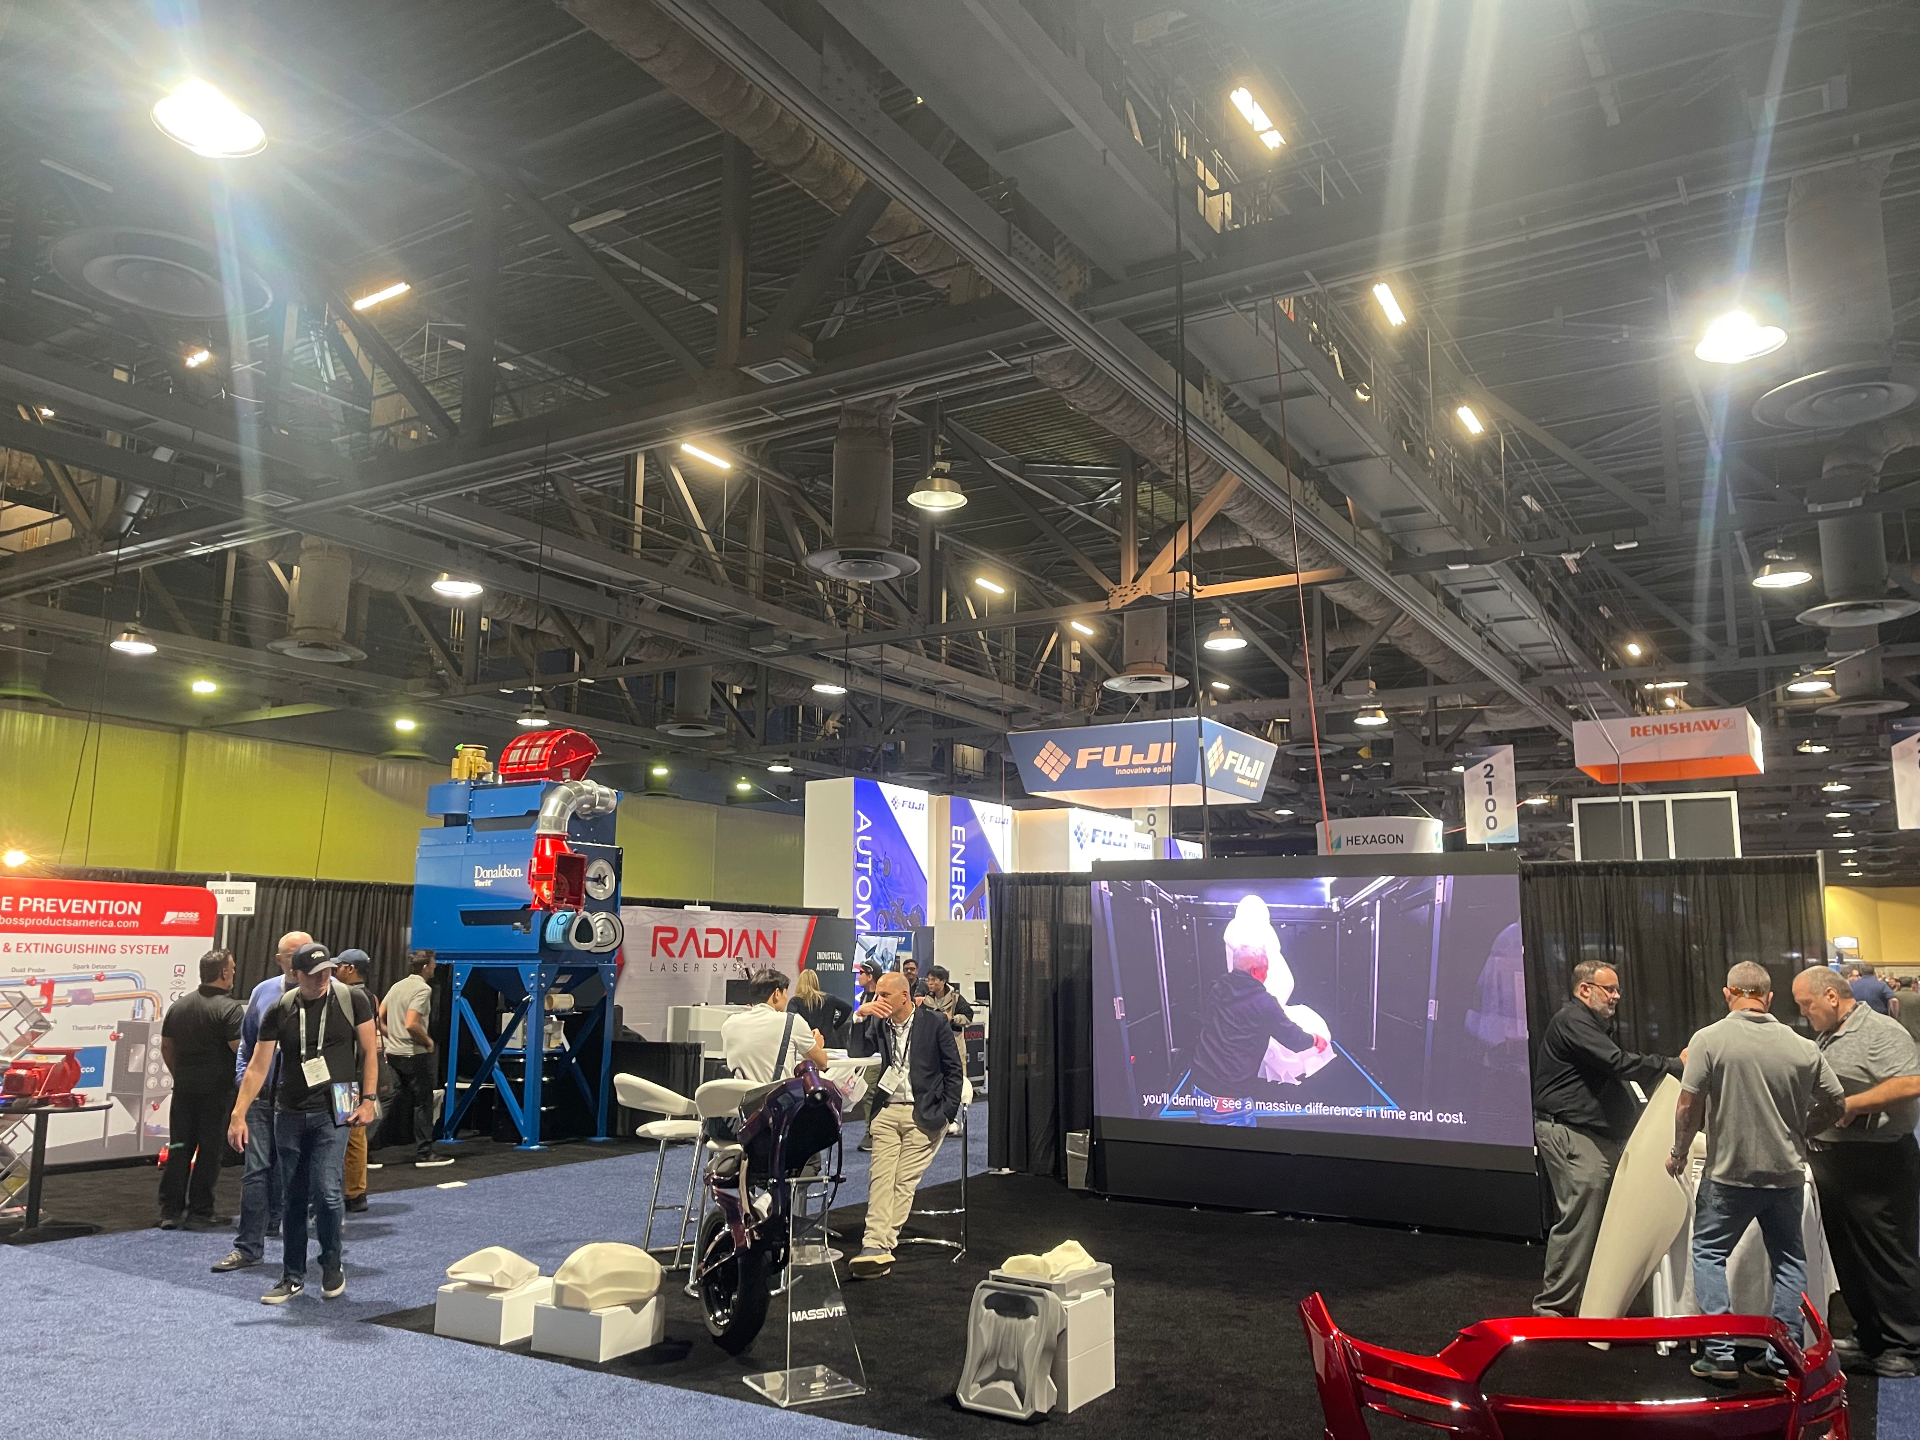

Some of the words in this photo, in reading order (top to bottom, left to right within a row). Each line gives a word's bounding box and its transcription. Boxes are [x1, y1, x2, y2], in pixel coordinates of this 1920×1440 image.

[1631, 719, 1721, 737] RENISHAW
[1075, 742, 1177, 769] FUJI
[1115, 767, 1151, 776] innovative
[1222, 750, 1266, 781] FUJI
[901, 800, 925, 811] FUJI
[1482, 763, 1498, 831] 2100
[1091, 828, 1128, 848] FUJI
[1346, 834, 1404, 846] HEXAGON
[474, 864, 523, 879] Donaldson
[19, 897, 141, 915] PREVENTION
[3, 942, 12, 953] &
[16, 942, 117, 954] EXTINGUISHING
[120, 944, 169, 955] SYSTEM
[651, 926, 777, 958] RADIAN
[650, 963, 700, 972] LASER
[816, 962, 845, 971] AUTOMATION
[1143, 1092, 1170, 1107] you'll
[1172, 1094, 1219, 1110] definitely
[1222, 1099, 1242, 1110] see
[1245, 1101, 1252, 1110] a
[1255, 1100, 1302, 1113] massive
[1305, 1102, 1363, 1118] difference
[1366, 1106, 1377, 1119] in
[1380, 1107, 1407, 1120] time
[1409, 1109, 1433, 1122] and
[1436, 1111, 1467, 1124] cost.
[792, 1306, 845, 1322] MASSIVIT
